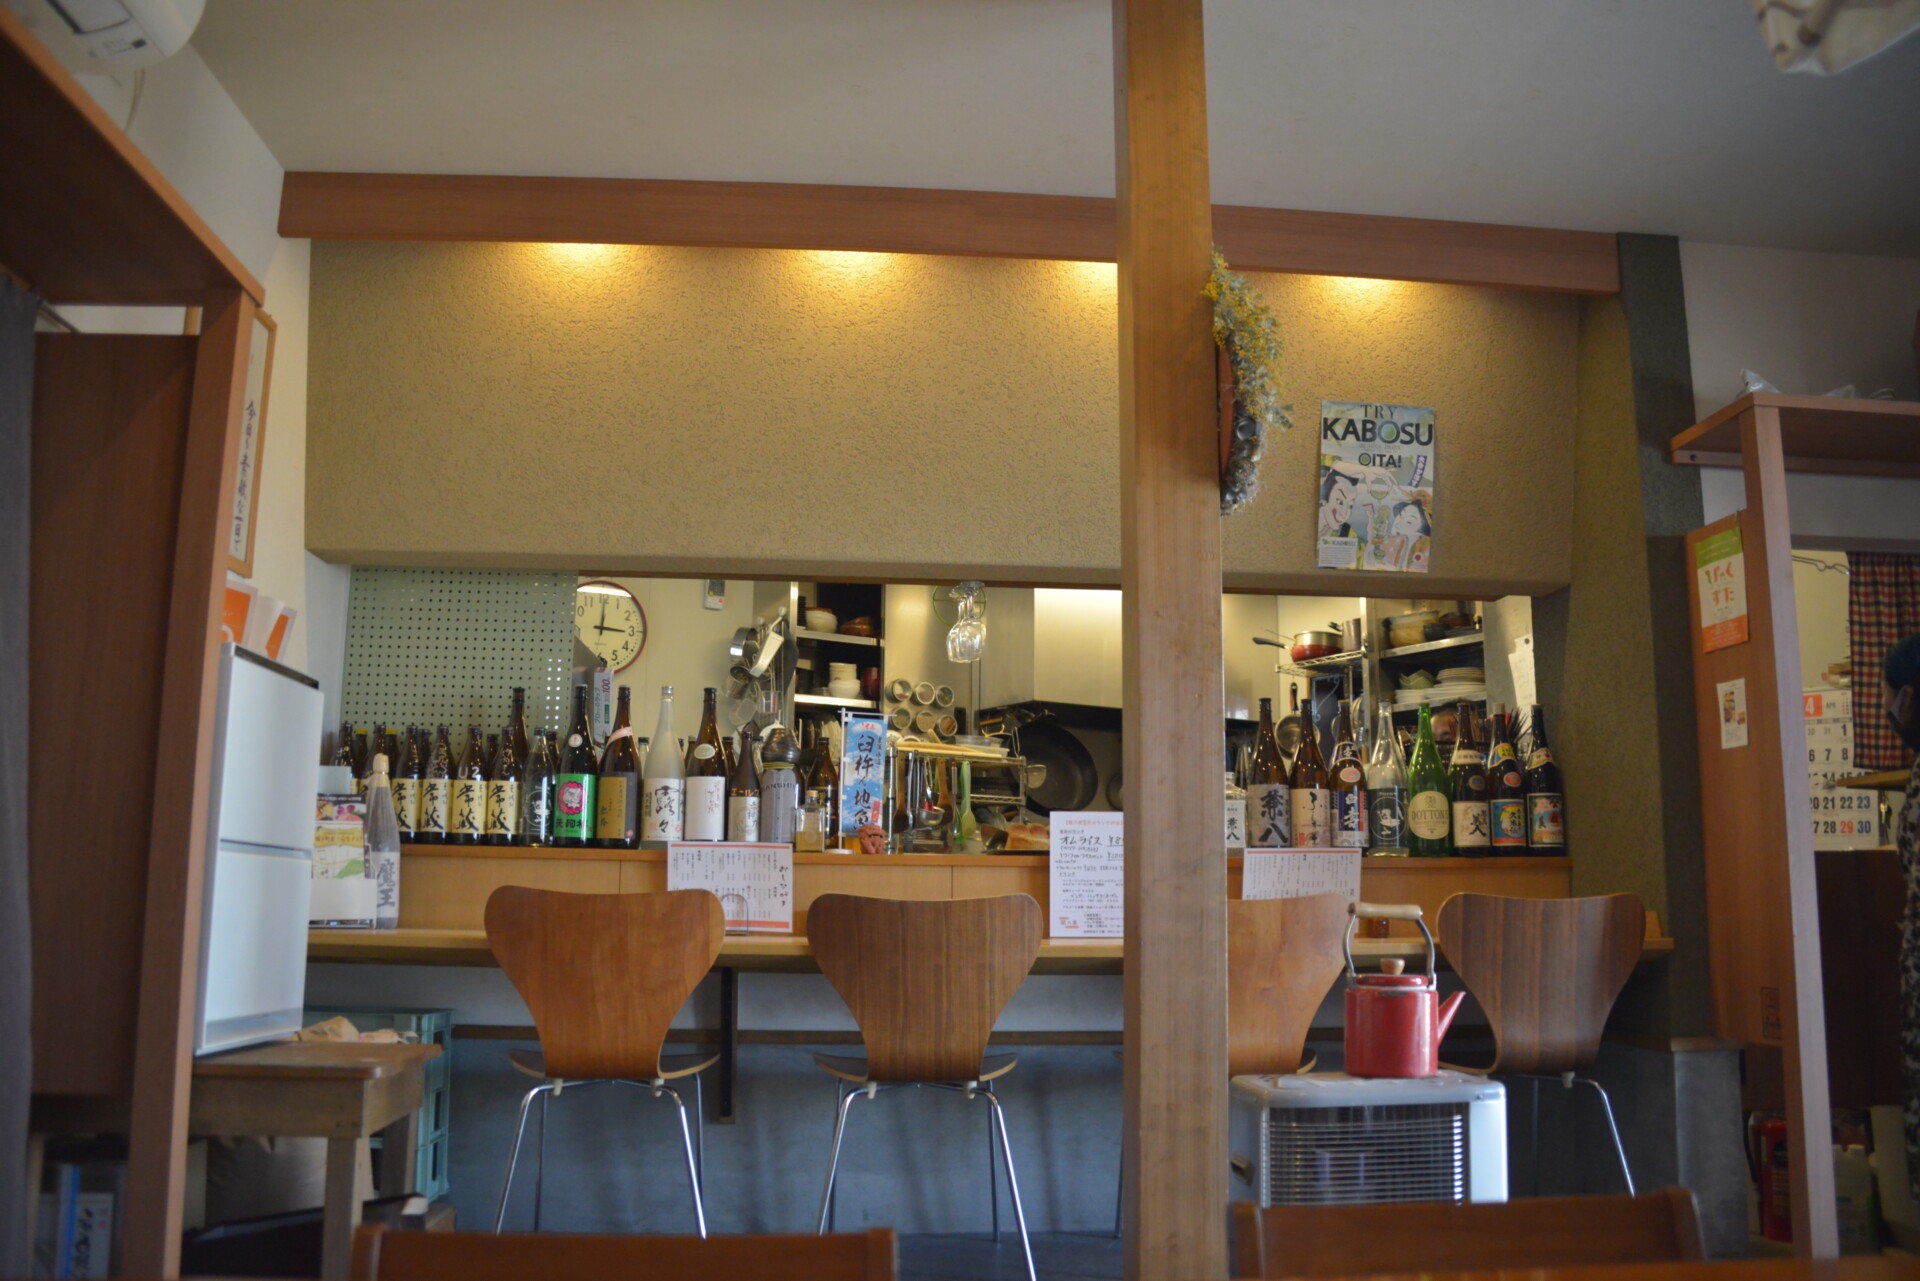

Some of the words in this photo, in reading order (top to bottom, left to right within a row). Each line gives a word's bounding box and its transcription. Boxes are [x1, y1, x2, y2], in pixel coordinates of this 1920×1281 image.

[1361, 404, 1398, 419] TRY
[1323, 417, 1433, 446] KABOSU
[1359, 453, 1402, 468] OITA!
[584, 596, 593, 607] 11
[624, 610, 631, 621] 2
[628, 625, 635, 637] 3
[622, 640, 629, 651] 4
[611, 650, 618, 661] 5
[602, 679, 610, 694] 100
[1806, 697, 1815, 715] 4
[1841, 724, 1846, 736] 1
[1809, 749, 1815, 762] 6
[1825, 748, 1831, 761] 7
[1842, 748, 1848, 761] 8
[1823, 797, 1835, 810] 21
[1840, 796, 1853, 809] 22
[1857, 796, 1871, 809] 23
[1259, 789, 1288, 843] 兼八
[1823, 821, 1836, 834] 28
[1840, 820, 1854, 834] 29
[1857, 821, 1871, 834] 30
[1060, 835, 1103, 846] オムライス
[377, 859, 396, 908] 魔王
